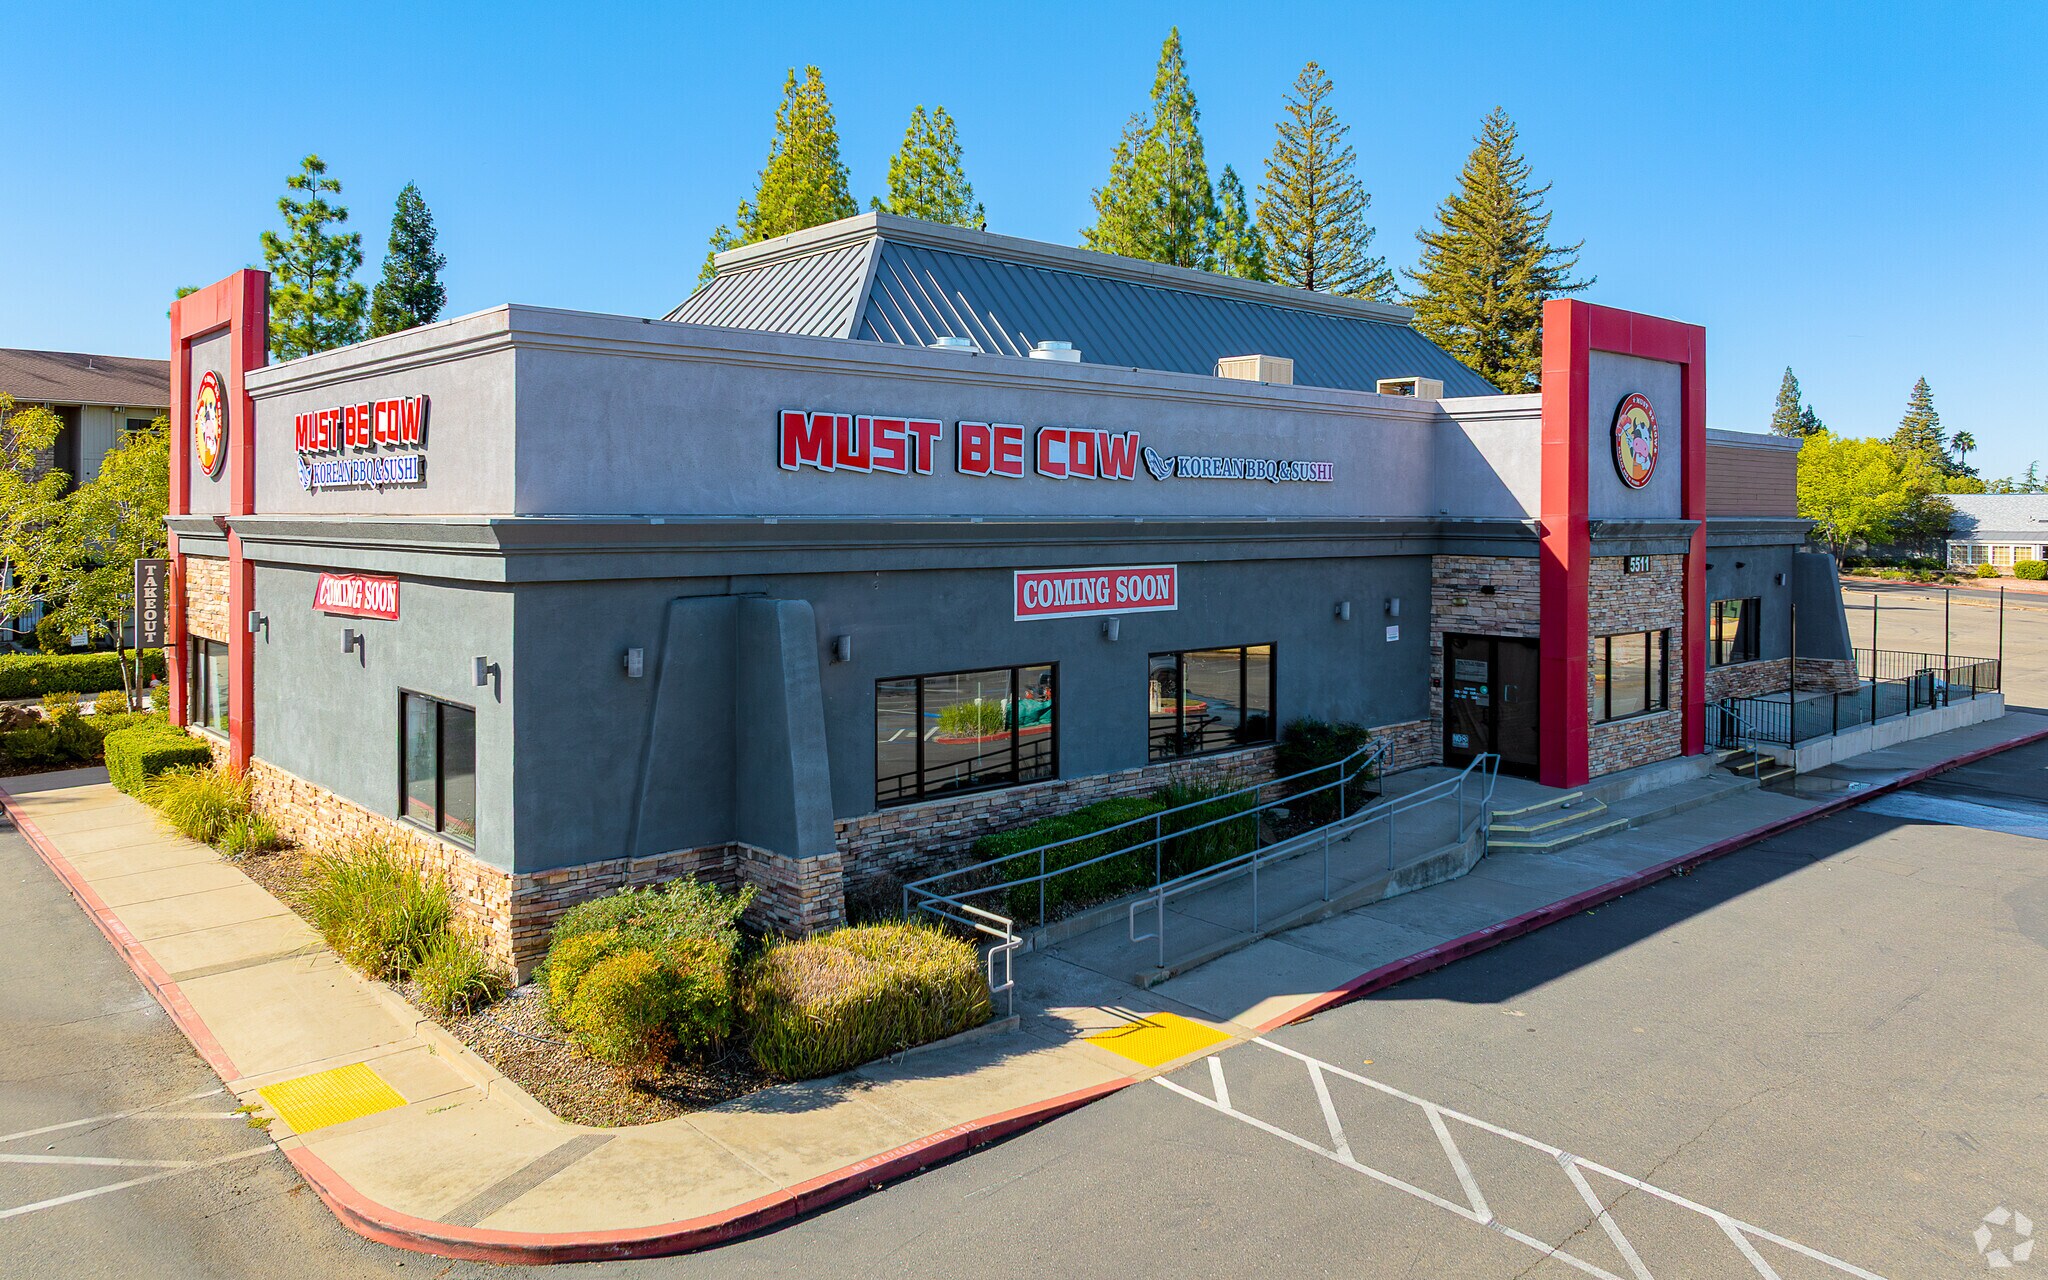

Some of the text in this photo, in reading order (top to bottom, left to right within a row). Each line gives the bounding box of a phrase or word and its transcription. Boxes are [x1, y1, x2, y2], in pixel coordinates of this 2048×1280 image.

[295, 394, 423, 454] MUST BE COW
[780, 409, 1141, 481] MUST BE COW
[313, 461, 351, 485] KOREAN
[352, 459, 375, 488] BBQ
[384, 456, 419, 482] SUSHI
[1177, 456, 1244, 479] KOREAN
[1248, 459, 1279, 483] BBQ
[1291, 461, 1334, 482] SUSHI
[1630, 556, 1649, 572] 5511
[144, 565, 158, 643] TAKEOUT
[319, 578, 397, 612] COMING SOON
[1023, 574, 1171, 609] COMING SOON
